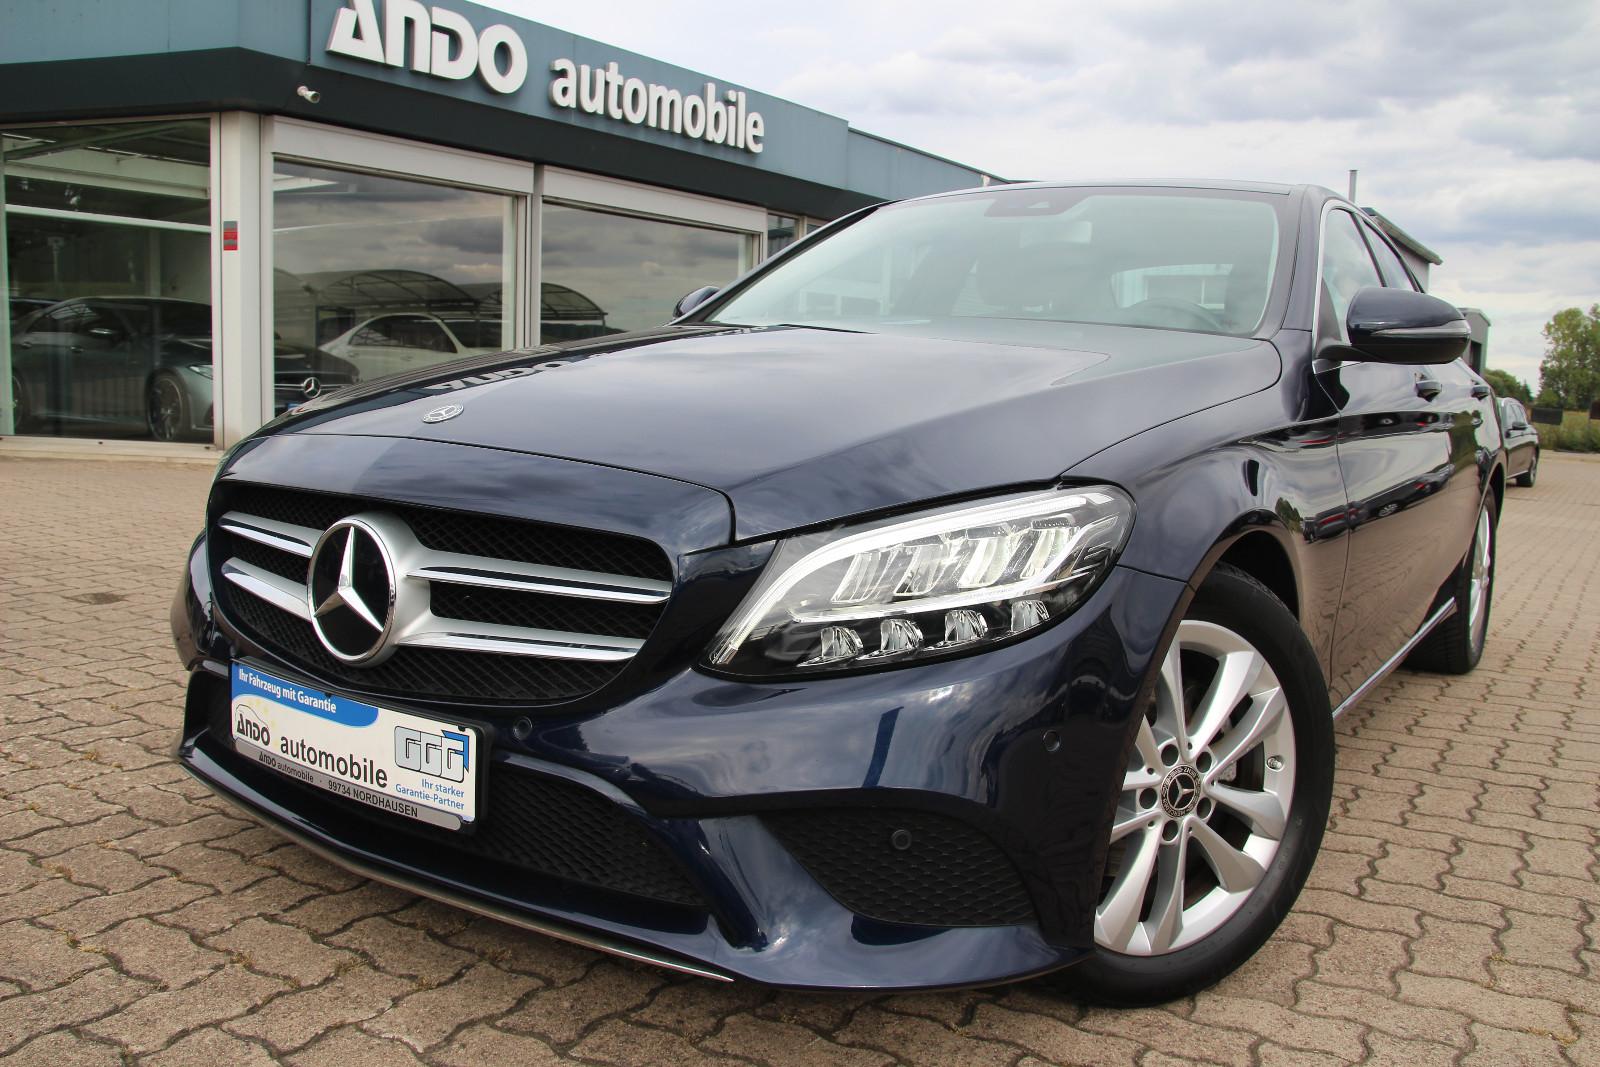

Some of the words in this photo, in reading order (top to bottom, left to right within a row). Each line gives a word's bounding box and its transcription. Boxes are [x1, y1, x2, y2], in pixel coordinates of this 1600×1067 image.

[550, 58, 764, 153] automobile
[239, 668, 248, 683] Ihr
[248, 674, 281, 698] Fahrzeug
[282, 687, 297, 701] mit
[297, 691, 336, 713] Garantie
[280, 736, 388, 788] automobile
[277, 760, 314, 783] automobile
[328, 780, 350, 796] 99734
[353, 788, 418, 818] NORDHAUSEN
[395, 783, 464, 810] Garantie-Partner
[421, 778, 433, 789] Ihr
[435, 783, 464, 798] starker
